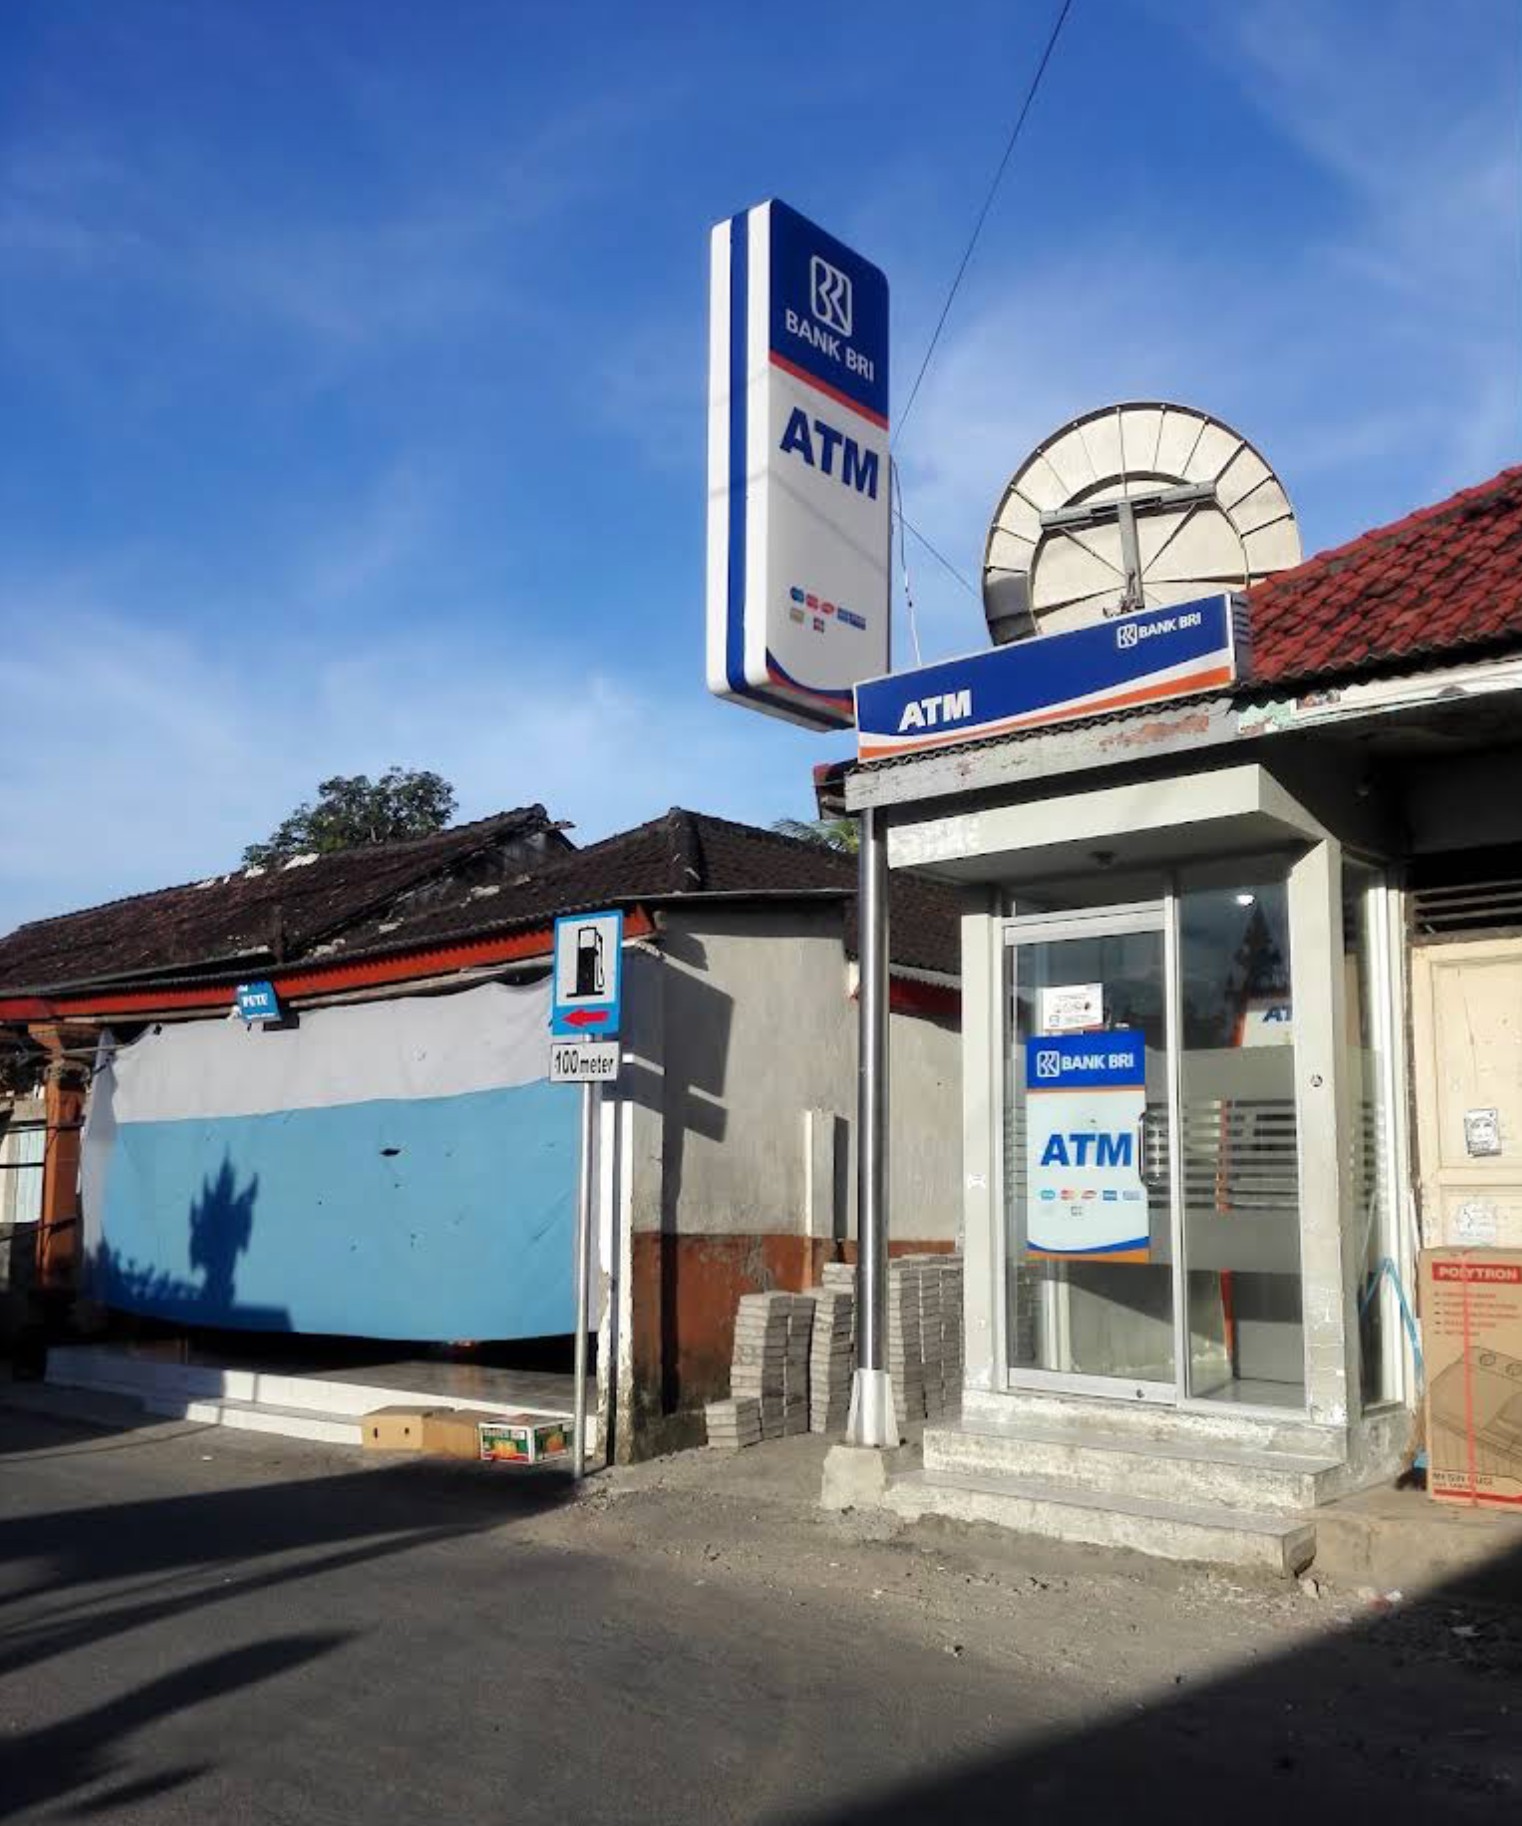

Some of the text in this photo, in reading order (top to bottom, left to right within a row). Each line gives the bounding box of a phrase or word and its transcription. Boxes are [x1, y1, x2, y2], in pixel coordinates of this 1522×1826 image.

[785, 308, 875, 381] BANK BRI
[779, 406, 879, 501] ATM
[1139, 612, 1202, 639] BANK BRI
[898, 689, 972, 732] ATM
[1262, 1006, 1292, 1022] AT
[1061, 1053, 1134, 1070] BANK BRI
[1040, 1133, 1132, 1167] ATM
